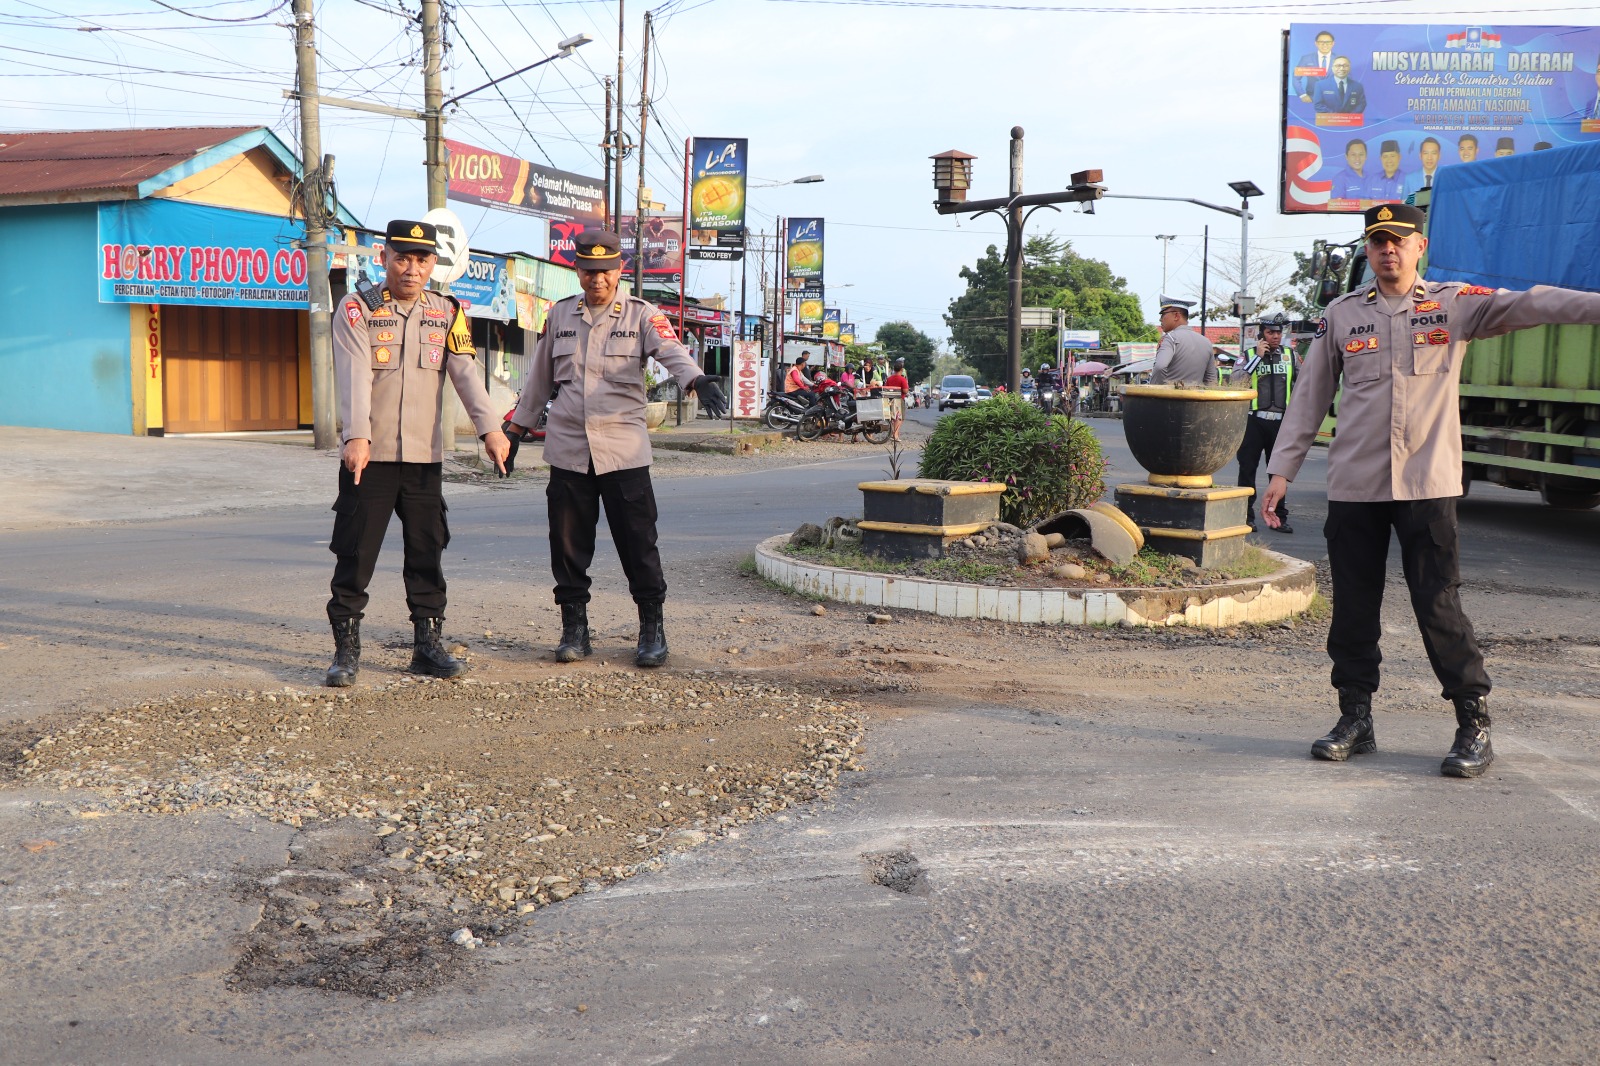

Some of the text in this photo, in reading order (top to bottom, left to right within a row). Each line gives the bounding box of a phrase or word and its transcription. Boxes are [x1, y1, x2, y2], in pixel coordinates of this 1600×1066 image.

[1372, 52, 1574, 72] MUSYAWARAH DAERAH
[1395, 72, 1554, 86] Serentak Se Sumatera Selatan
[1419, 87, 1522, 97] DEWAN PERWAKILAN DAERAH
[1407, 99, 1532, 112] PARTAI AMANAT NASIONAL
[1414, 114, 1523, 125] KABUPATEN MUSI RAWAS
[449, 153, 503, 181] VIGOR
[532, 172, 603, 199] Selamat Menunaikan
[570, 196, 593, 212] Puasa
[695, 215, 728, 223] MANGO
[700, 220, 742, 228] SEASON!
[699, 251, 715, 259] TOKO
[189, 246, 270, 284] PHOTO
[273, 248, 308, 287] CO
[467, 260, 496, 281] COPY
[114, 284, 155, 297] PERCETAKAN
[160, 285, 180, 298] CETAK
[180, 286, 197, 298] FOTO
[201, 286, 236, 300] FOTOCOPY
[240, 287, 277, 302] PERALATAN
[278, 289, 309, 302] SEKOLAH
[368, 319, 449, 330] FREDDY POLRI
[1411, 313, 1448, 327] POLRI
[610, 331, 639, 339] POLRI
[1349, 323, 1375, 336] ADJI
[1256, 364, 1288, 375] POLISI
